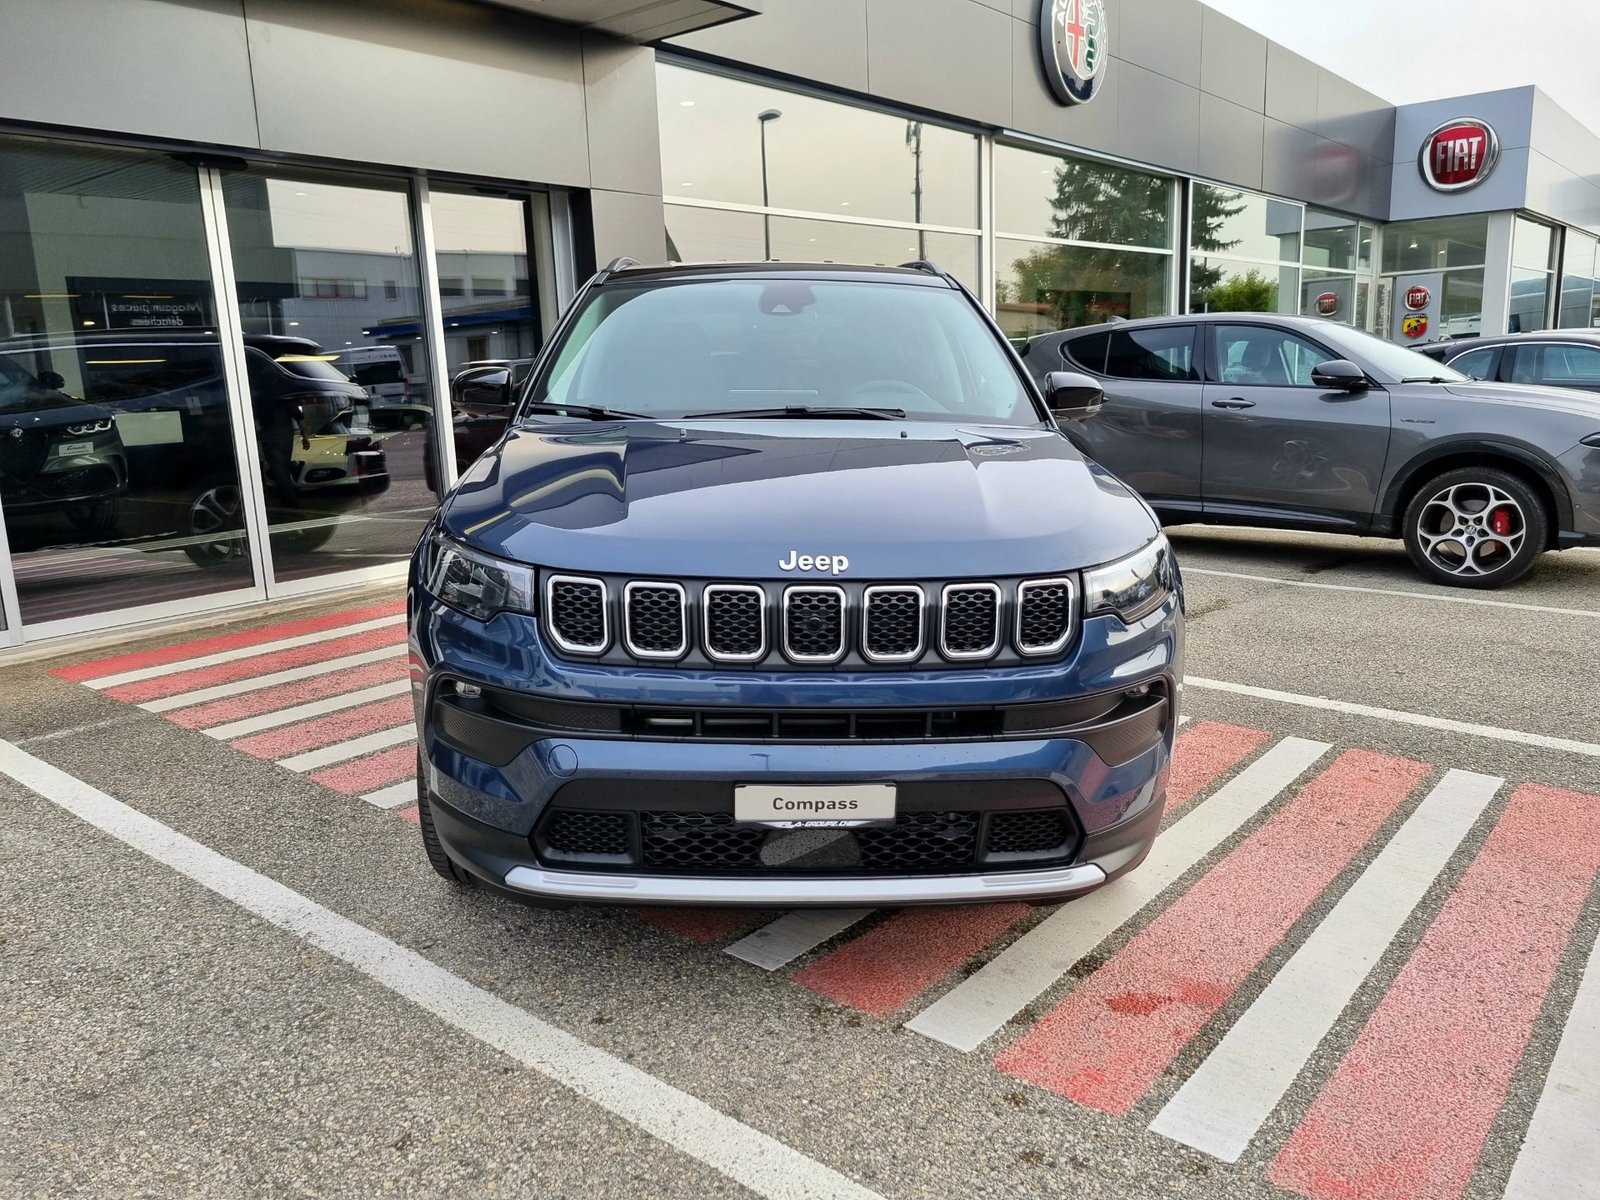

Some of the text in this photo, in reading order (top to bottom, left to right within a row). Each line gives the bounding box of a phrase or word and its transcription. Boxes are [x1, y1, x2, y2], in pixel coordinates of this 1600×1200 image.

[1436, 136, 1482, 174] FIAT
[1409, 292, 1426, 305] FIAT
[778, 550, 849, 575] Jeep
[773, 797, 858, 812] Compass
